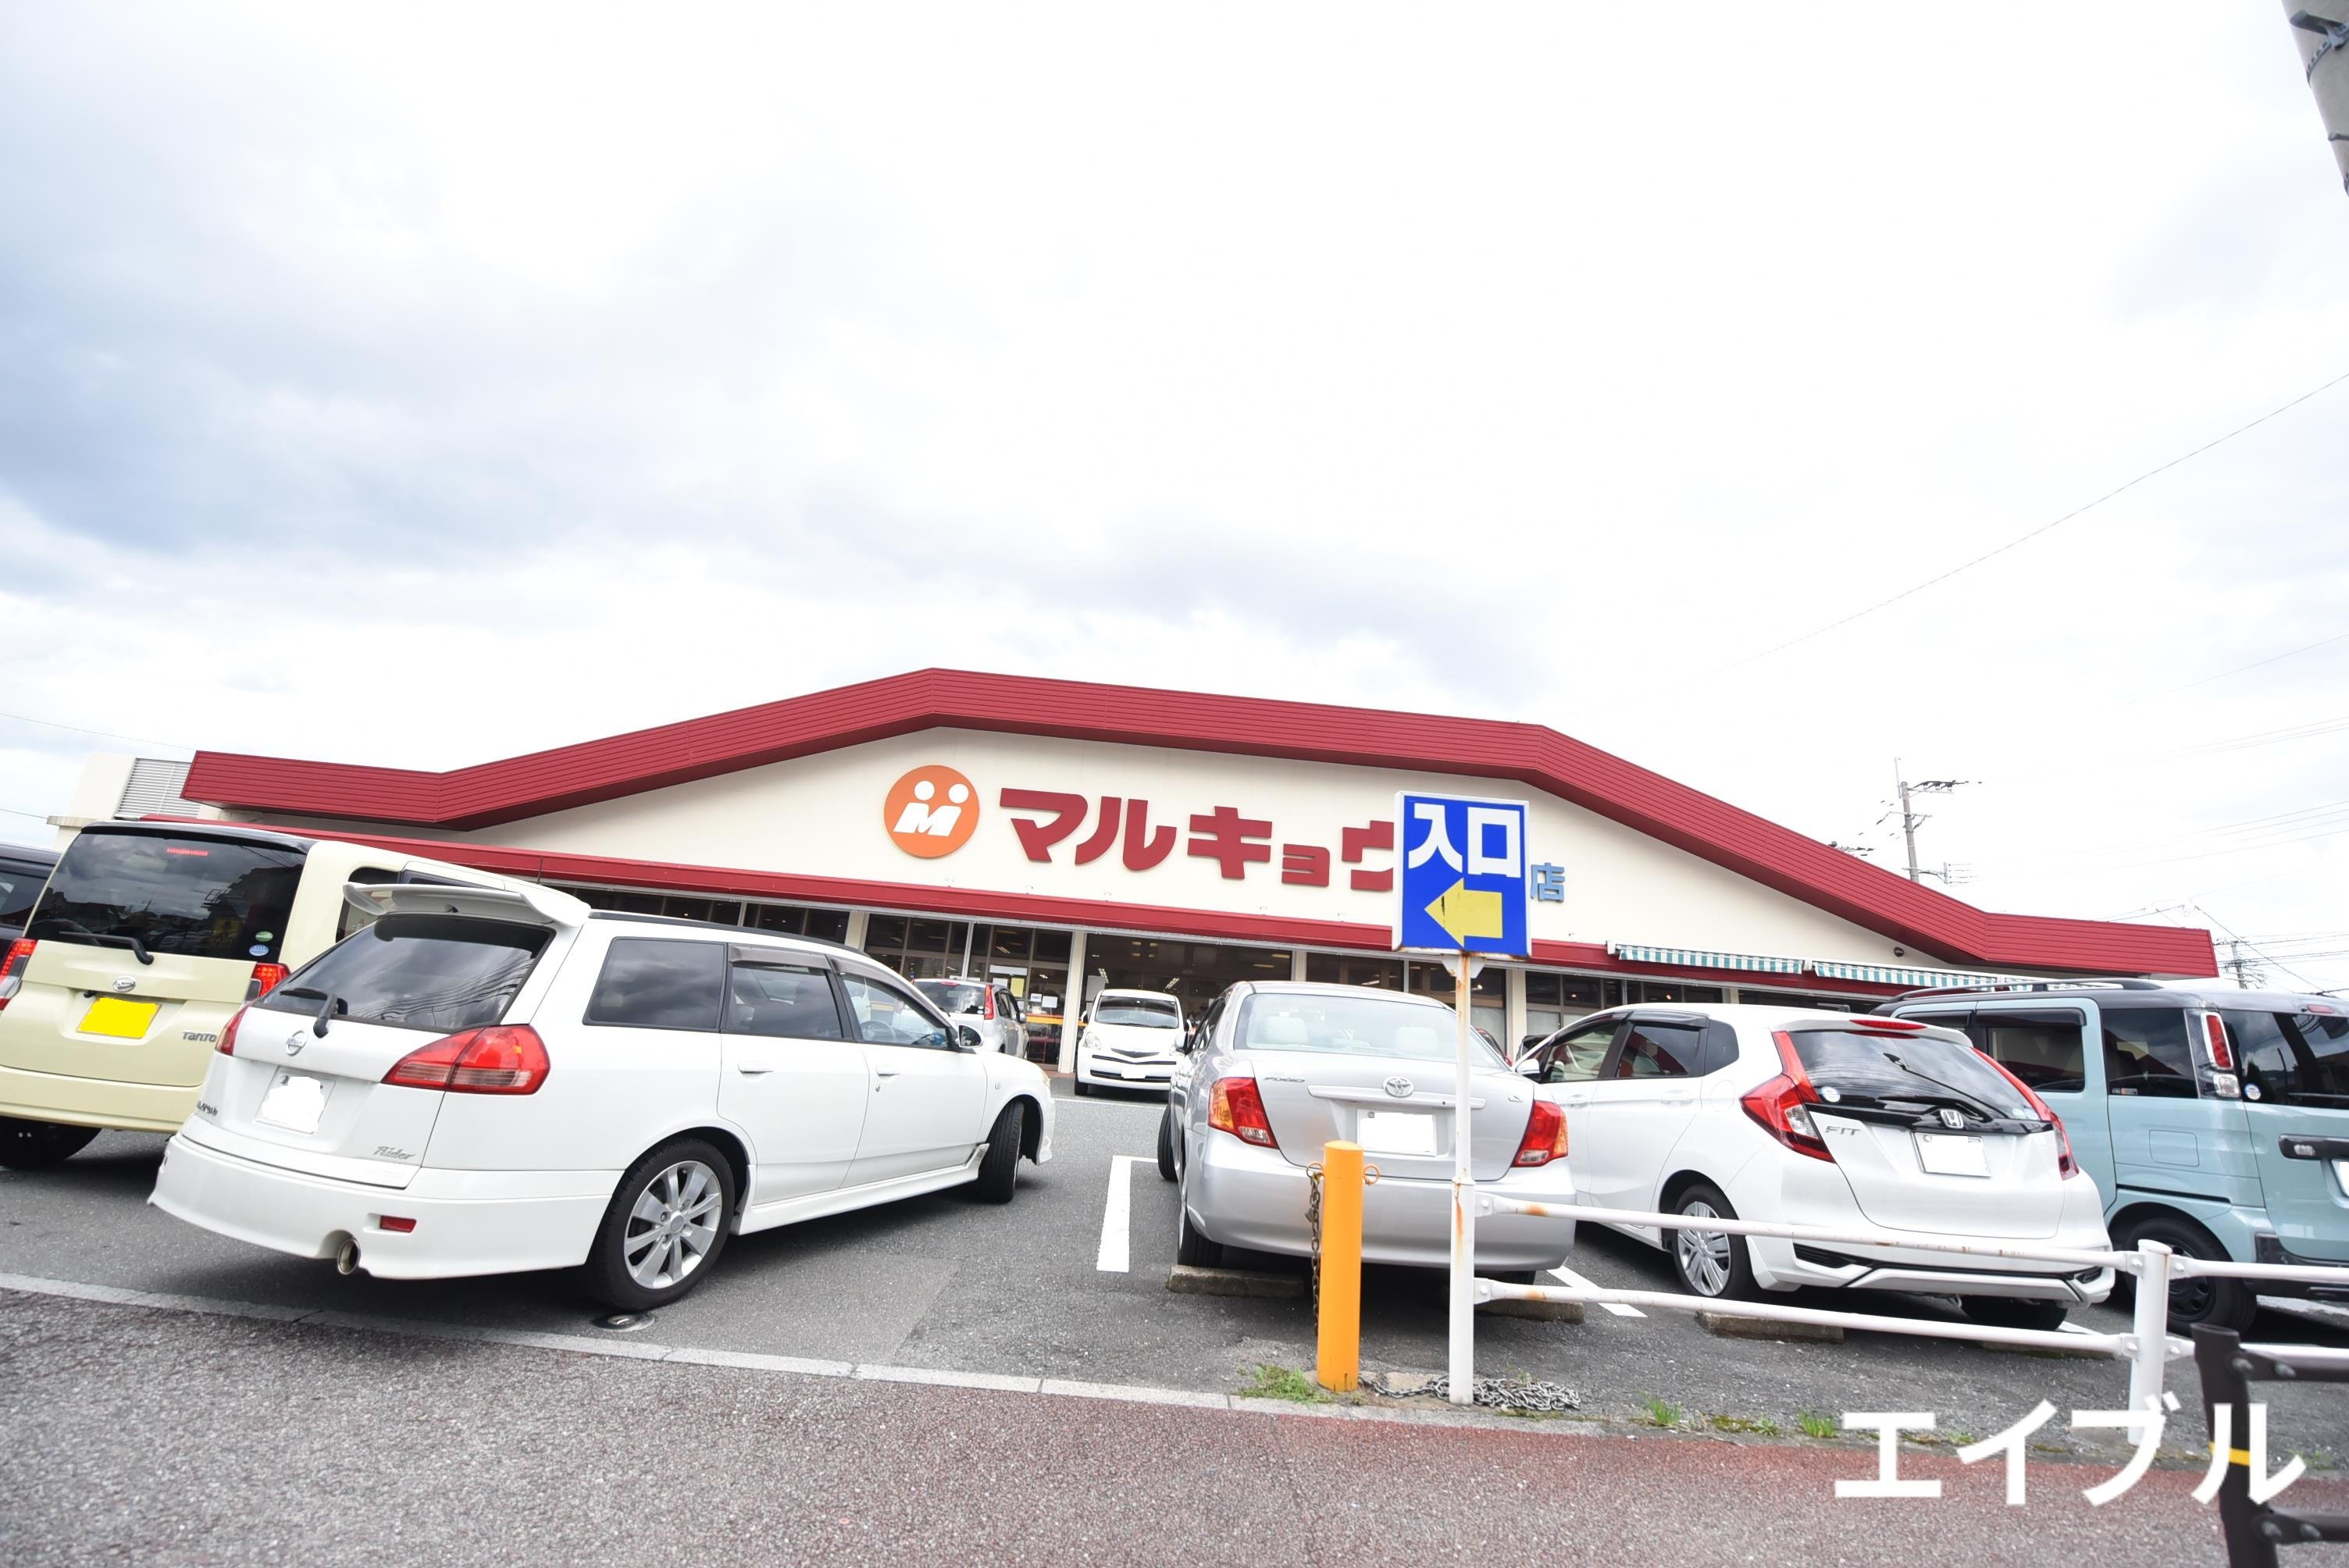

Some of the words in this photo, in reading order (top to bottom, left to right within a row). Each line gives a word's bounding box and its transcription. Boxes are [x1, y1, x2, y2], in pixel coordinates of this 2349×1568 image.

[1408, 802, 1522, 878] 入口
[1530, 862, 1566, 903] 店
[1825, 1125, 1861, 1136] FIT
[373, 1146, 415, 1160] Rider
